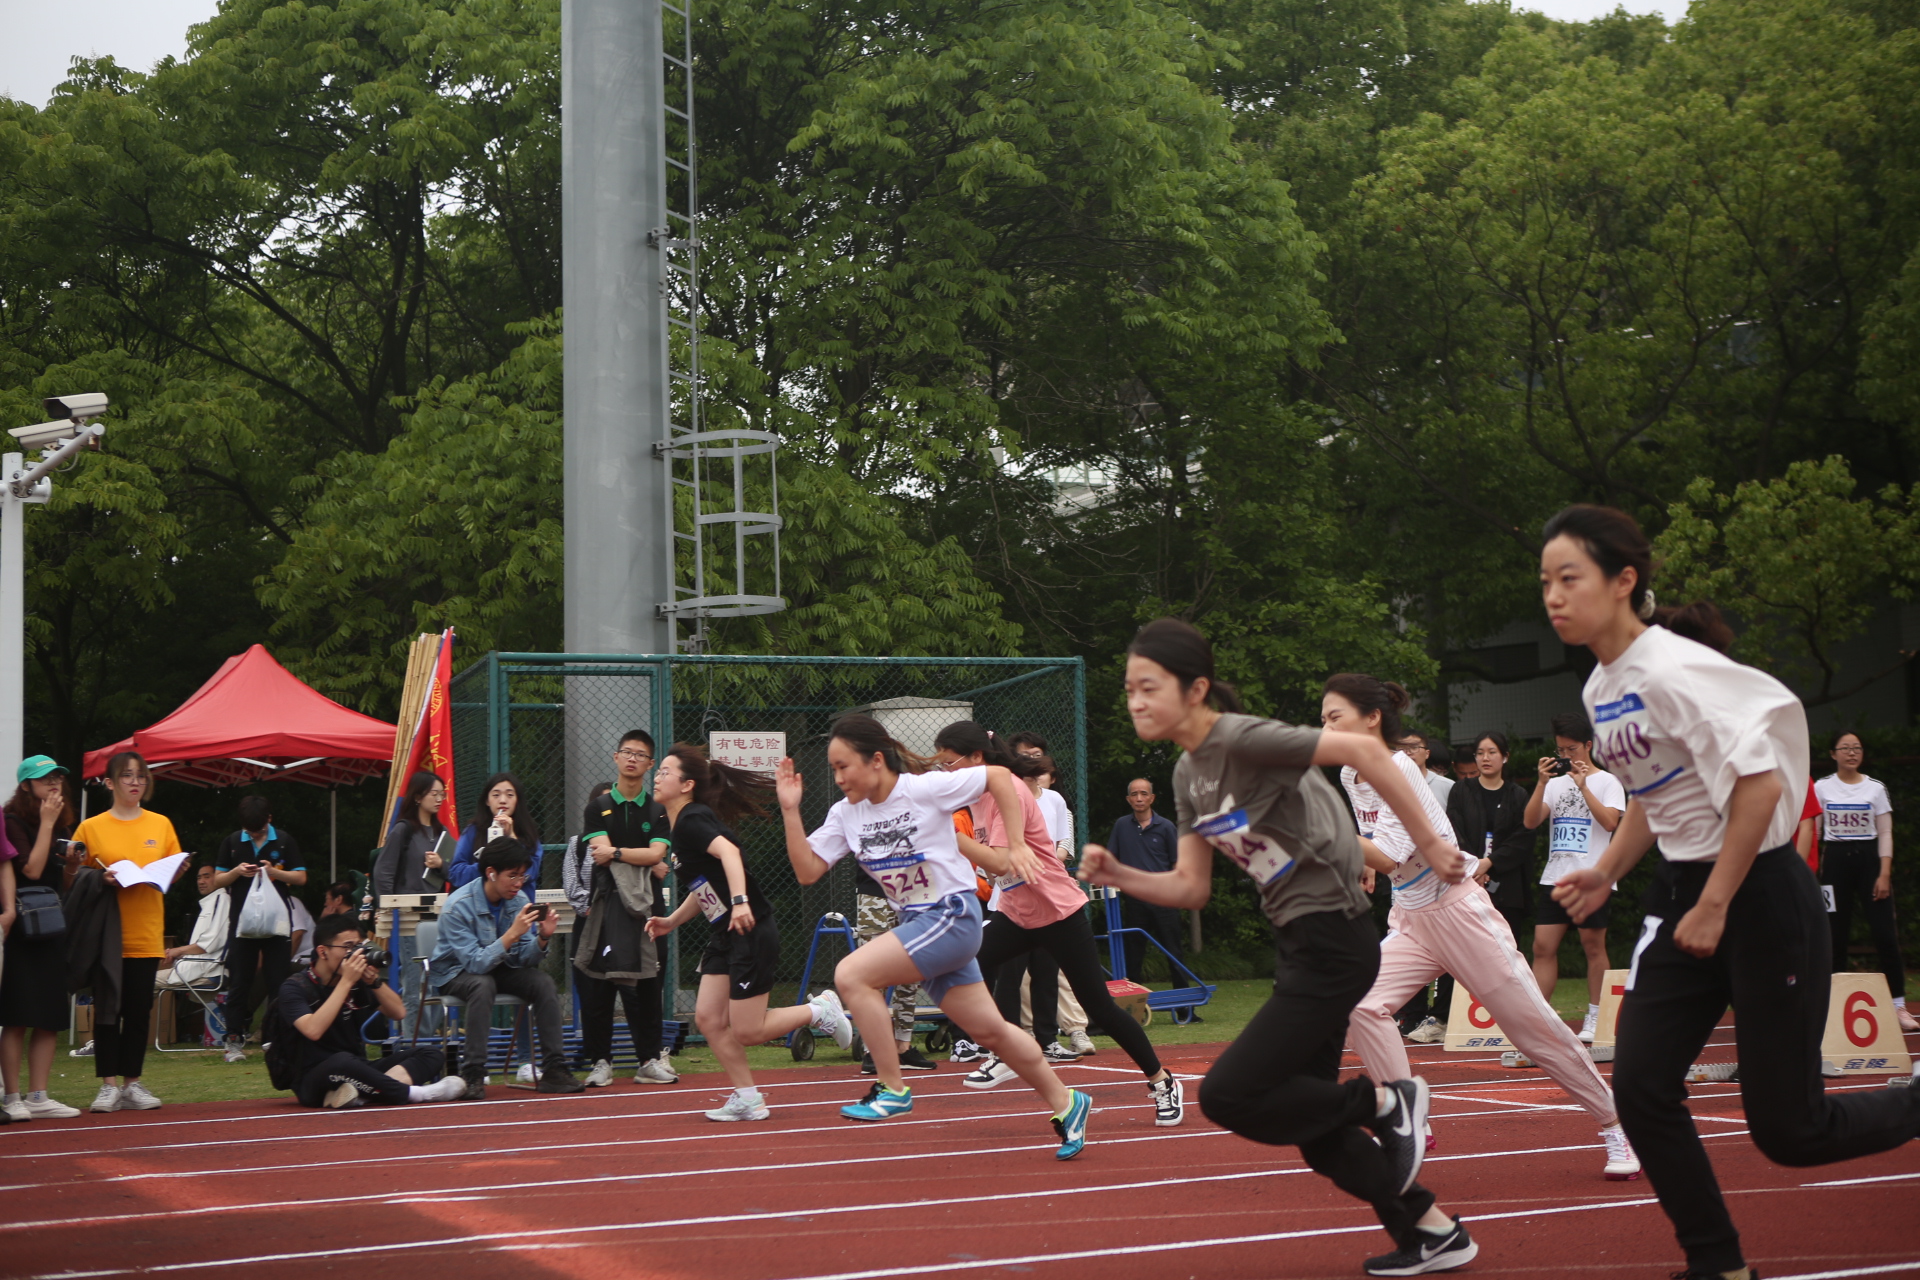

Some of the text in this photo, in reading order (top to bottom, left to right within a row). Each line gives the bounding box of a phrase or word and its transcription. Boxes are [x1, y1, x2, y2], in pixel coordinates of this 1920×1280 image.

[716, 738, 780, 750] 有电危险
[717, 756, 780, 768] 禁止攀爬
[1828, 812, 1870, 827] B485
[1553, 826, 1587, 842] B035
[881, 866, 929, 896] 524
[1843, 990, 1879, 1048] 6
